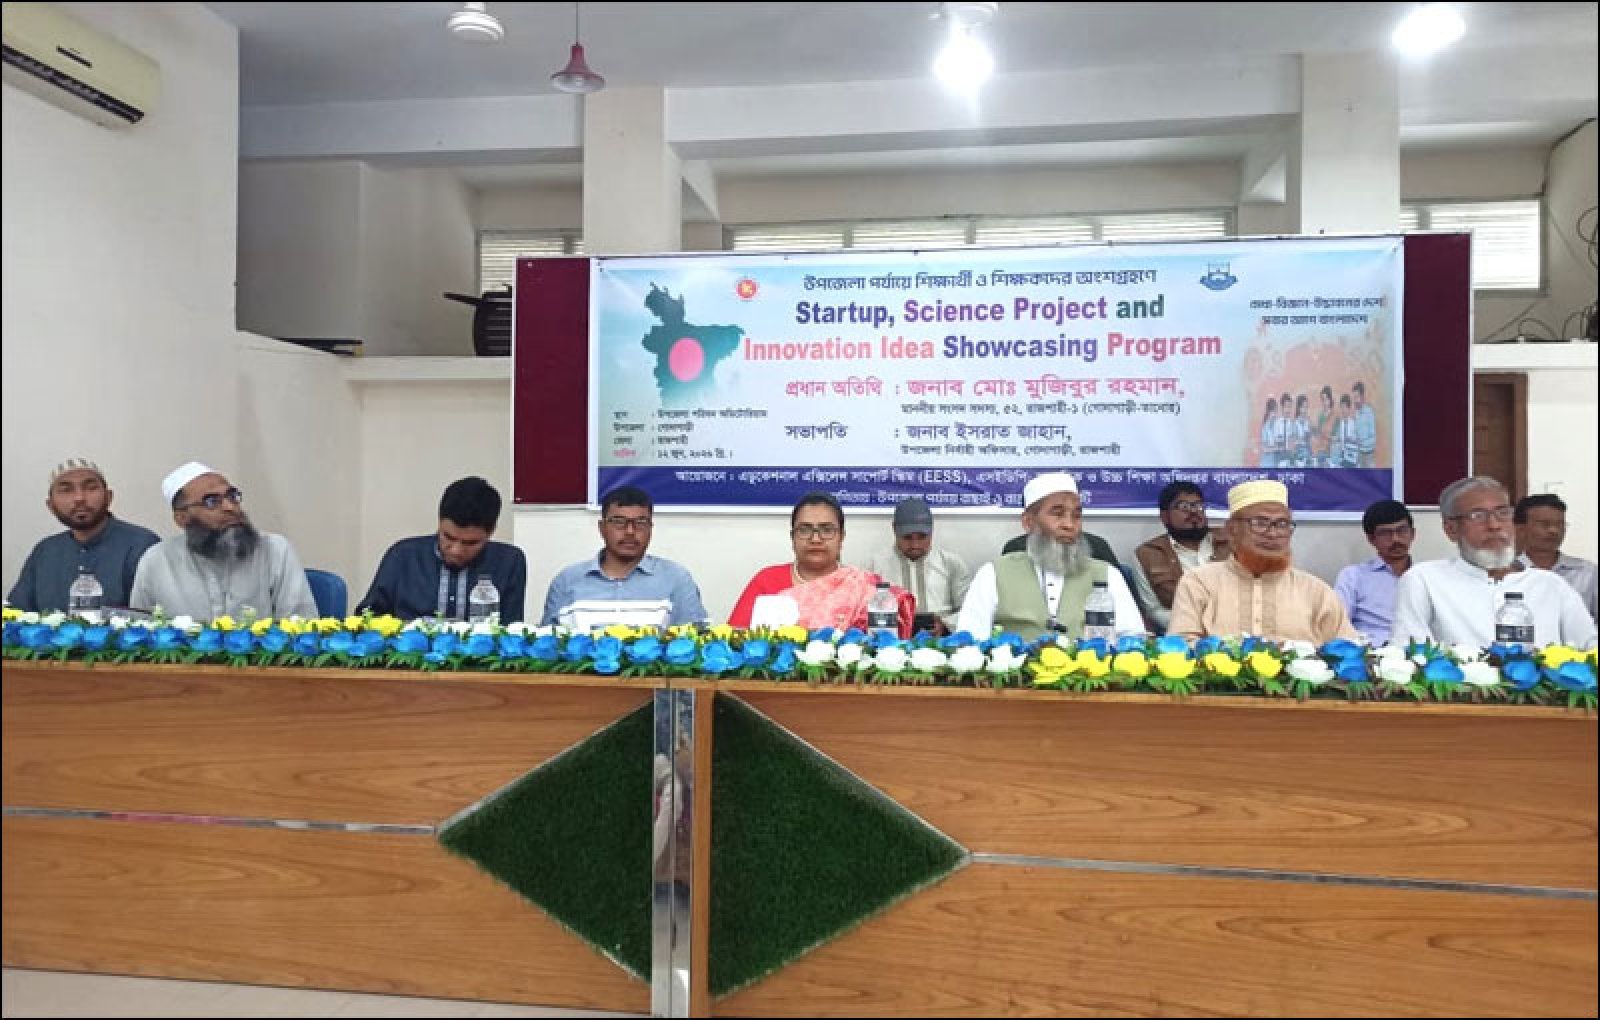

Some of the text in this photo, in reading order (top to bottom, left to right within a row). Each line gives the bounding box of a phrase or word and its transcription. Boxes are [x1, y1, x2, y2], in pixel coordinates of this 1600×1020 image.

[803, 269, 1157, 290] উপজেলা পর্যায়ে শিক্ষার্থী ও শিক্ষকদের অংশগ্রহণে
[795, 294, 1165, 328] Startup, Science Project and
[743, 331, 1223, 362] Innovation Idea Showcasing Program
[785, 379, 826, 397] প্রধান
[832, 375, 884, 397] অতিথি
[907, 379, 965, 397] জনাব
[973, 379, 1017, 397] মোঃ
[1024, 374, 1100, 400] মুজিবুর
[1106, 377, 1185, 398] রহমান,
[785, 421, 849, 440] সভাপতি
[907, 425, 950, 440] জনাব
[955, 422, 1012, 440] ইসরাত
[1017, 425, 1072, 442] জাহান,
